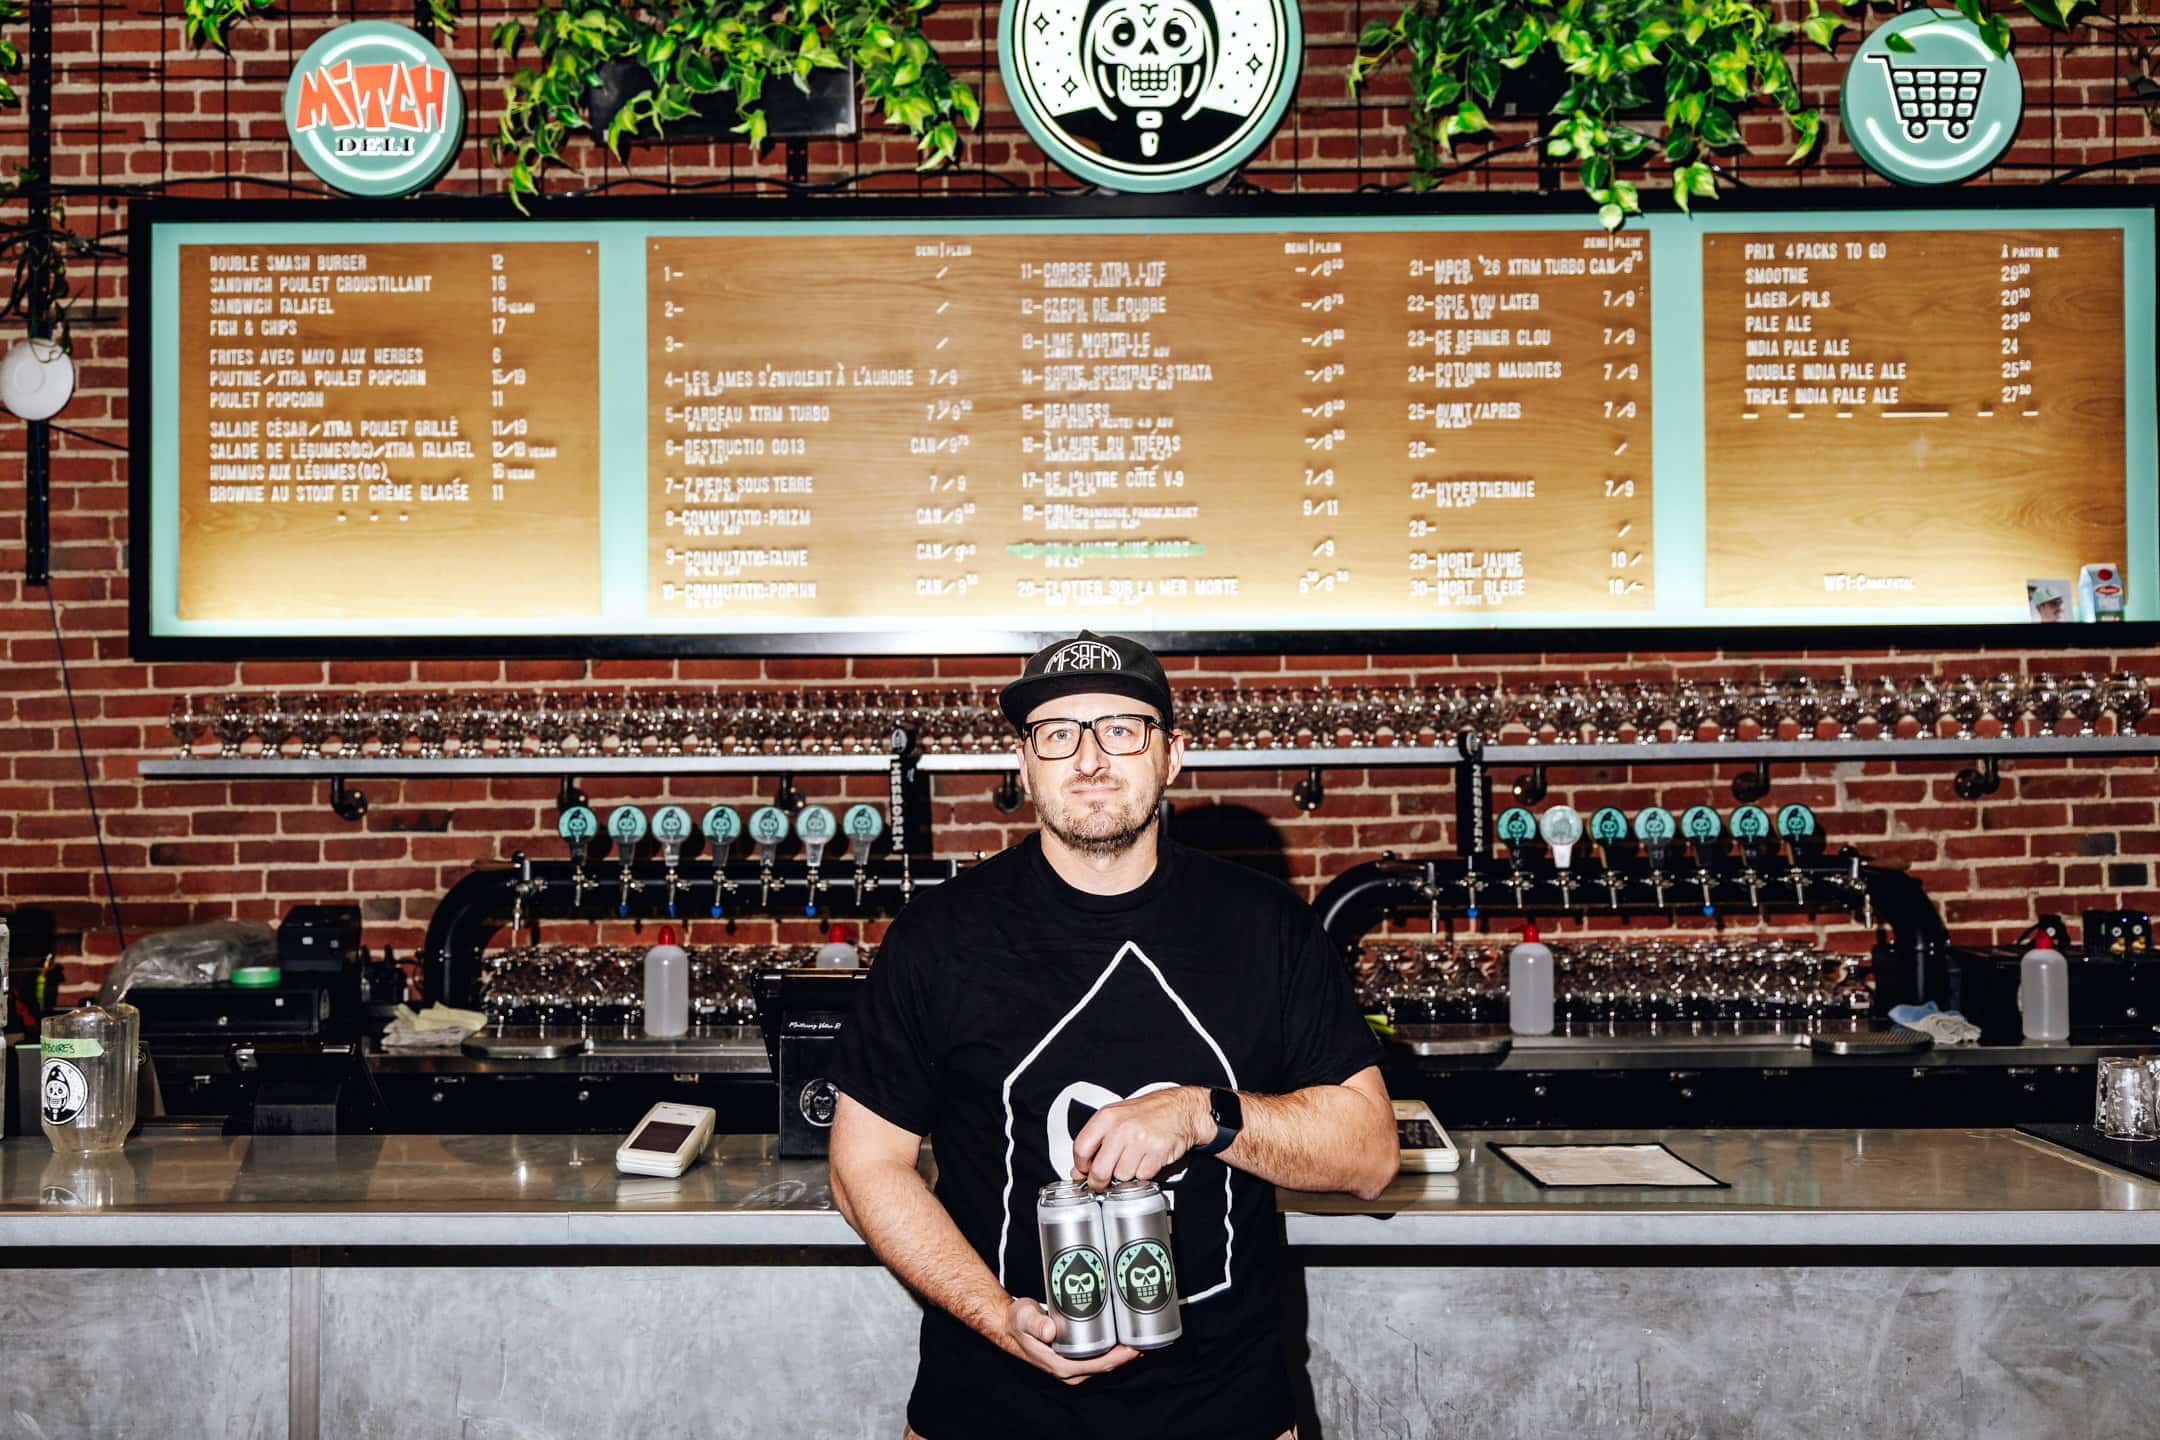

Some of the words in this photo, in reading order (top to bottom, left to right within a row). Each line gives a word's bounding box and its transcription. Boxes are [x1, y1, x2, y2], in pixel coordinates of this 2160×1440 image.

[335, 136, 415, 156] DELI
[1745, 244, 1775, 260] PRIX
[1846, 243, 1862, 259] TO
[1869, 243, 1886, 259] GO
[2012, 248, 2043, 258] PARTIR
[210, 255, 259, 272] DOUBLE
[267, 255, 310, 272] SMASH
[318, 255, 367, 272] BURGER
[1101, 262, 1130, 278] XTRA
[1139, 262, 1167, 278] LITE
[1507, 259, 1541, 275] XTRM
[1545, 259, 1584, 275] TURBO
[210, 277, 272, 293] SANDWICH
[280, 277, 329, 293] POULET
[336, 277, 432, 293] CROUSTILLANT
[491, 276, 506, 292] 16
[1745, 268, 1808, 284] SMOOTHIE
[210, 298, 272, 315] SANDWICH
[280, 298, 334, 315] FALAFEL
[1093, 297, 1108, 314] DE
[1119, 297, 1167, 314] FOUDRE
[1471, 294, 1495, 311] YOU
[1500, 294, 1539, 311] LATER
[210, 320, 237, 336] FISH
[245, 320, 253, 336] &
[261, 320, 297, 336] CHIPS
[491, 319, 506, 334] 17
[1745, 316, 1779, 332] PALE
[1785, 316, 1812, 332] ALE
[1083, 332, 1151, 349] MORTELLE
[1457, 329, 1509, 346] DERNIER
[1517, 329, 1551, 346] CLOU
[1746, 339, 1778, 356] INDIA
[1784, 339, 1817, 356] PALE
[1824, 339, 1849, 356] ALE
[2002, 338, 2018, 355] 24
[210, 349, 254, 365] FRITES
[260, 349, 294, 365] AVEC
[302, 349, 334, 365] MAYO
[342, 349, 366, 365] AUX
[375, 349, 423, 365] HERBES
[492, 348, 501, 364] 6
[717, 370, 753, 388] AMES
[837, 363, 845, 387] À
[1167, 366, 1213, 381] STRATA
[1498, 362, 1561, 378] MAUDITES
[1746, 363, 1796, 380] DOUBLE
[1803, 363, 1836, 380] INDIA
[1840, 363, 1874, 380] PALE
[1880, 363, 1906, 380] ALE
[315, 371, 361, 387] POULET
[369, 371, 426, 387] POPCORN
[210, 392, 260, 408] POULET
[267, 392, 324, 408] POPCORN
[491, 391, 503, 407] 11
[1745, 388, 1788, 405] TRIPLE
[1795, 388, 1828, 405] INDIA
[1833, 388, 1866, 405] PALE
[1872, 388, 1898, 405] ALE
[750, 405, 783, 423] XTRM
[789, 405, 829, 423] TURBO
[210, 421, 259, 438] SALADE
[361, 421, 409, 438] POULET
[415, 417, 458, 438] GRILLÉ
[1107, 436, 1124, 452] DU
[1132, 431, 1181, 452] TRÉPAS
[210, 442, 259, 459] SALADE
[267, 442, 283, 459] DE
[422, 442, 475, 459] FALAFEL
[210, 464, 264, 481] HUMMUS
[269, 464, 291, 481] AUX
[210, 485, 265, 503] BROWNIE
[271, 485, 289, 503] AU
[296, 485, 338, 503] STOUT
[342, 485, 359, 503] ET
[369, 479, 412, 503] CRÈME
[420, 478, 469, 502] GLACÉE
[491, 485, 503, 501] 11
[737, 476, 769, 493] SOUS
[773, 476, 813, 493] TERRE
[1483, 552, 1522, 568] JAUNE
[1160, 578, 1186, 597] MER
[1195, 578, 1239, 597] MORTE
